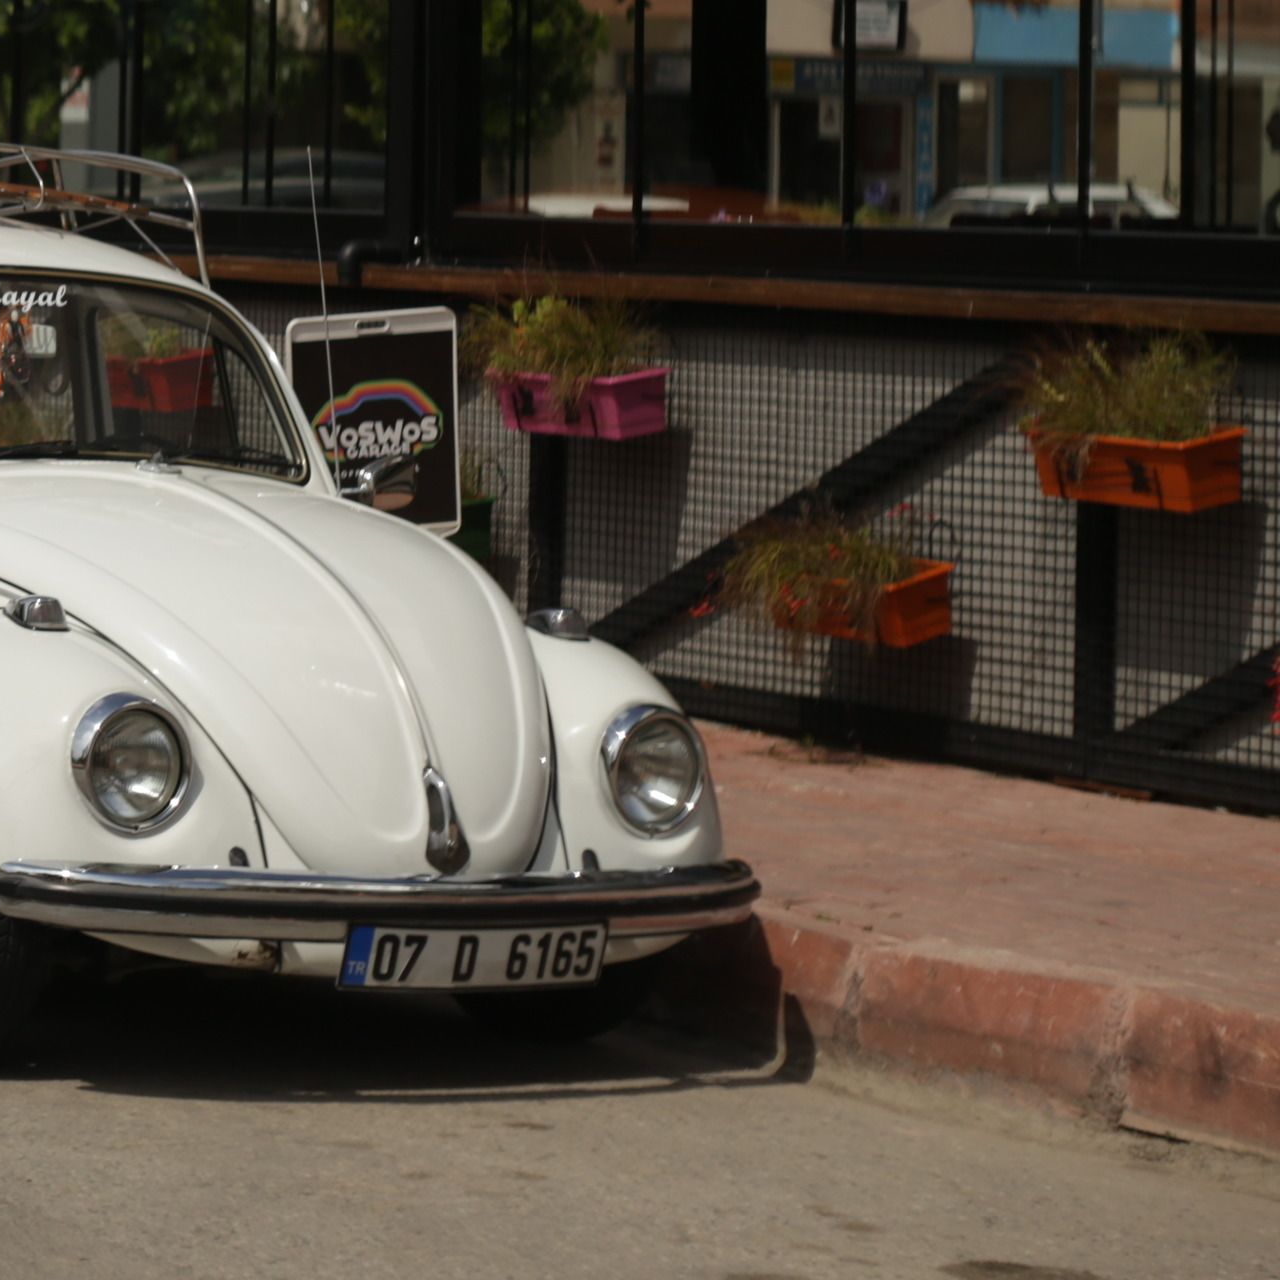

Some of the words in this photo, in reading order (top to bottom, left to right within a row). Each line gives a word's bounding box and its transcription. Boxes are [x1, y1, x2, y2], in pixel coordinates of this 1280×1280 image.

[318, 415, 439, 451] VOSWOS
[346, 440, 411, 460] GARAGE
[347, 960, 366, 976] TR
[371, 933, 428, 983] 07
[451, 934, 480, 984] D
[505, 929, 599, 981] 6165
